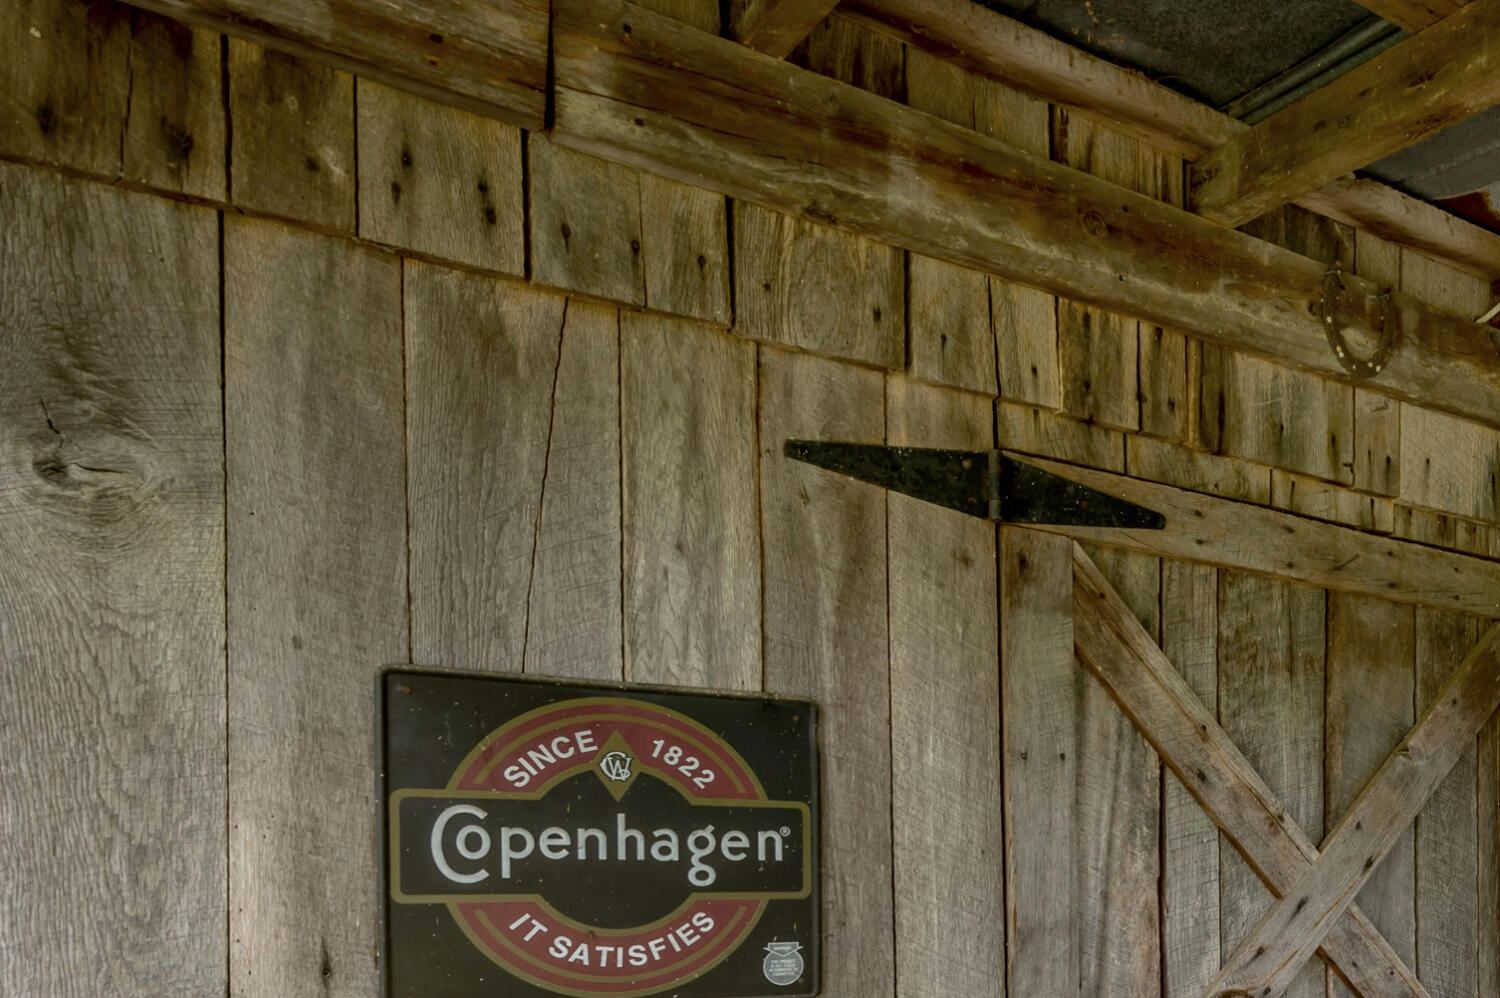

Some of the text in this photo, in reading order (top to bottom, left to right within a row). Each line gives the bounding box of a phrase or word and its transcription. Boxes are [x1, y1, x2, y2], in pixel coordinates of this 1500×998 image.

[503, 729, 717, 790] SINCE 1822
[508, 912, 549, 944] IT
[549, 911, 716, 968] SATISFIES
